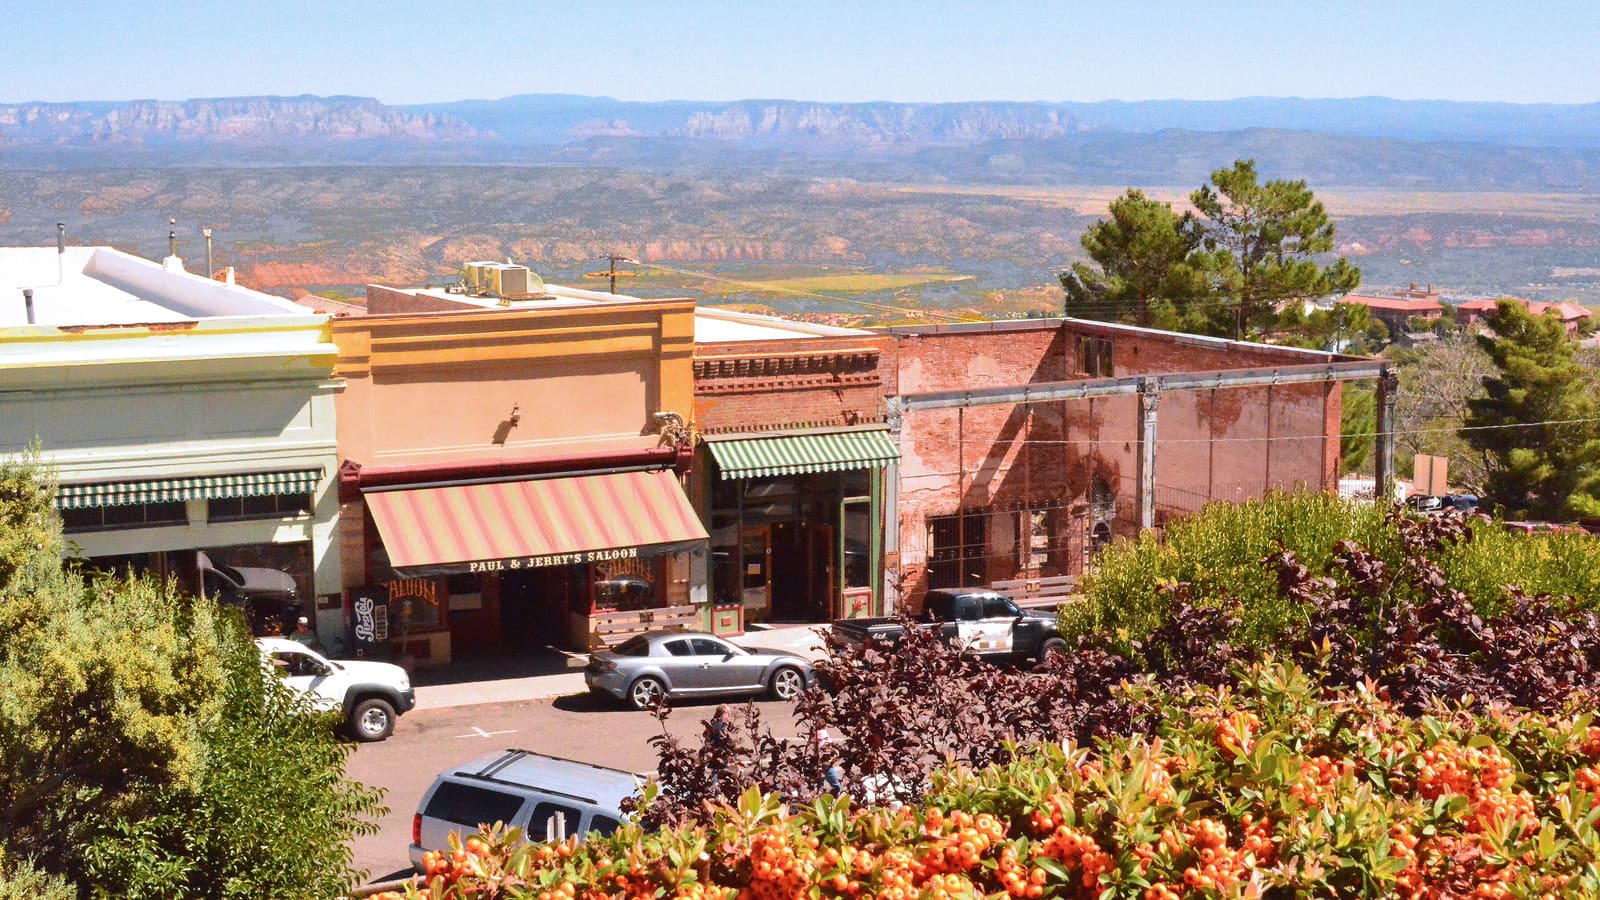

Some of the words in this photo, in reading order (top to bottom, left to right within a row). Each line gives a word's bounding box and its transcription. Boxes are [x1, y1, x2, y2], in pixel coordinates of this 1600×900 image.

[470, 561, 504, 572] PAUL
[510, 559, 521, 569] &
[527, 554, 582, 567] JERRY'S
[587, 548, 637, 561] SALOON
[382, 577, 439, 605] ALOON
